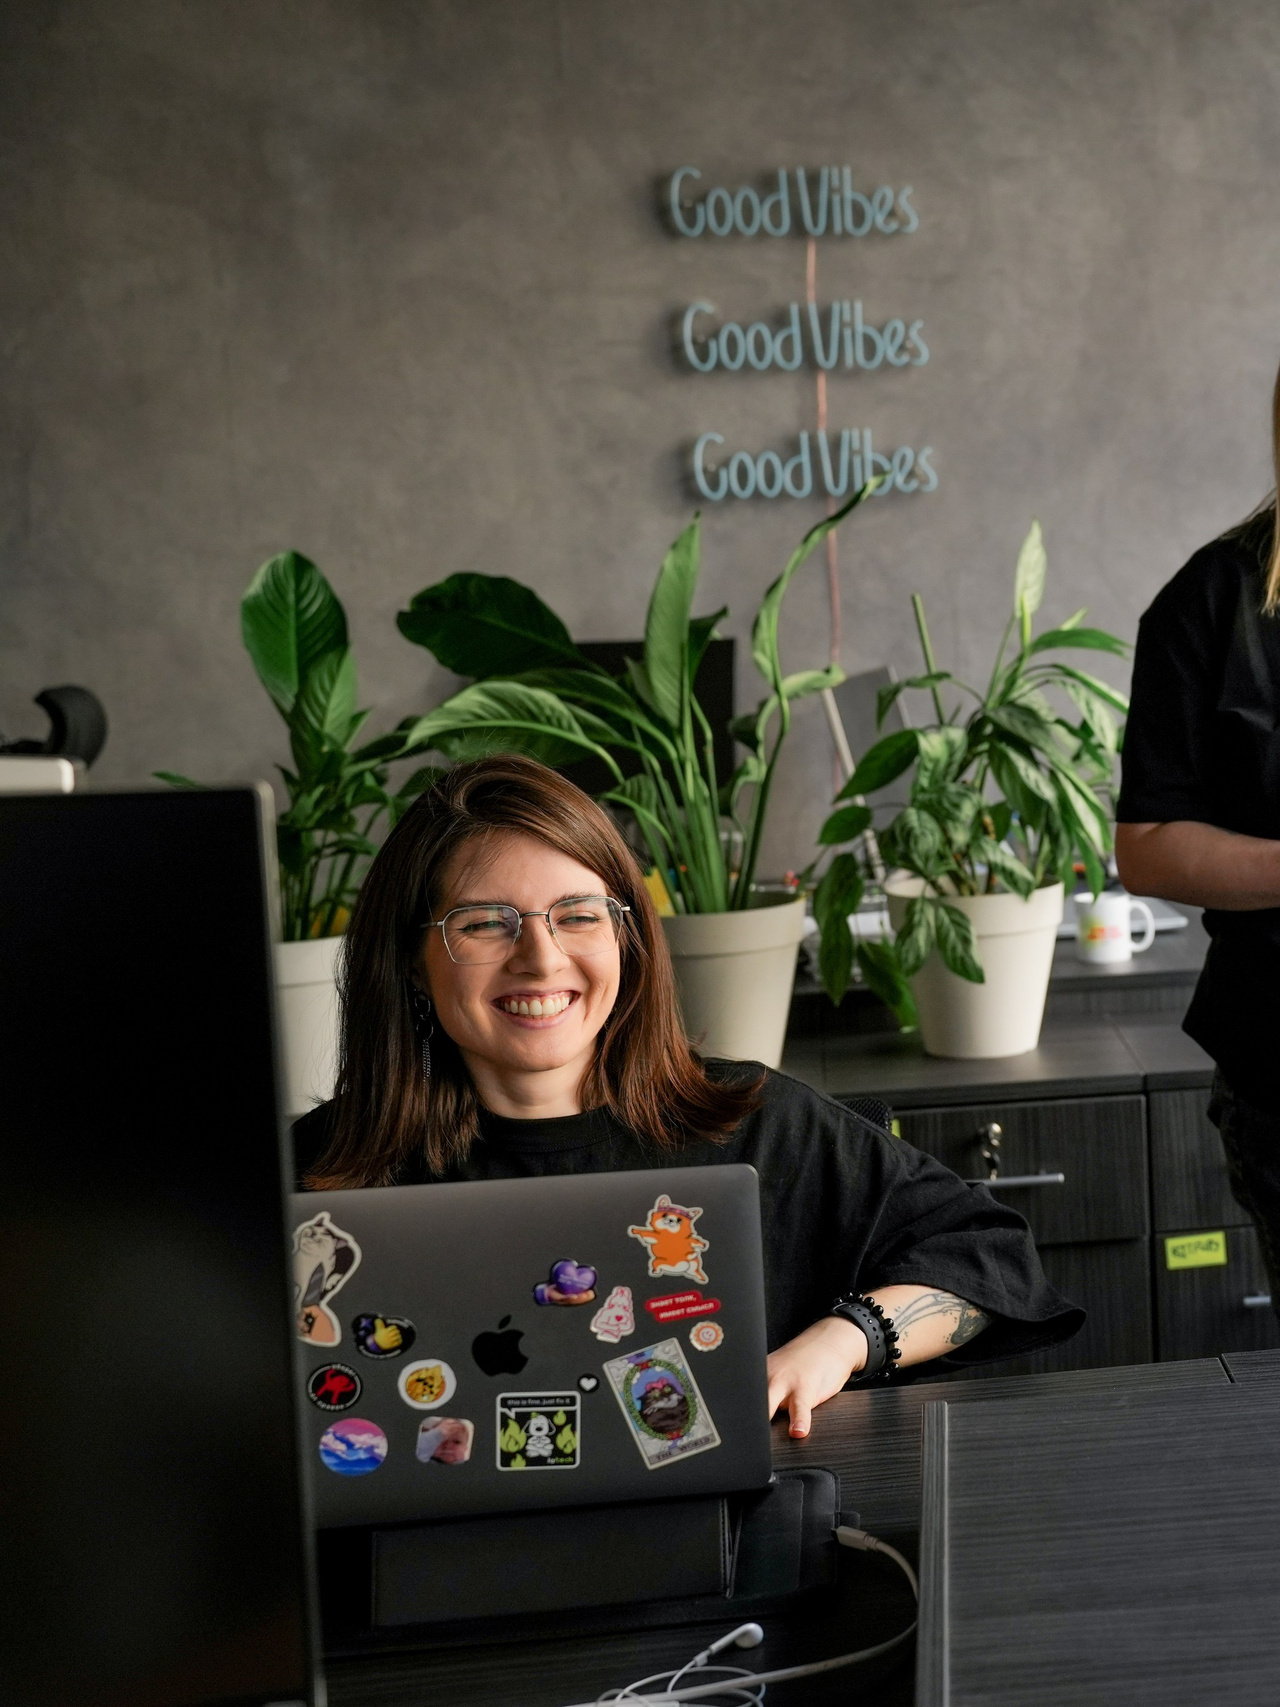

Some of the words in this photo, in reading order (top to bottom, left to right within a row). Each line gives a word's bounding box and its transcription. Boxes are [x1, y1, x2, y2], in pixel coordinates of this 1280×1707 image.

[670, 165, 791, 238] Good
[796, 164, 919, 237] Vibes
[683, 300, 802, 372] Good
[808, 299, 930, 371] Vibes
[694, 430, 813, 500] Good
[817, 426, 939, 498] Vibes
[680, 1437, 710, 1452] WORLD
